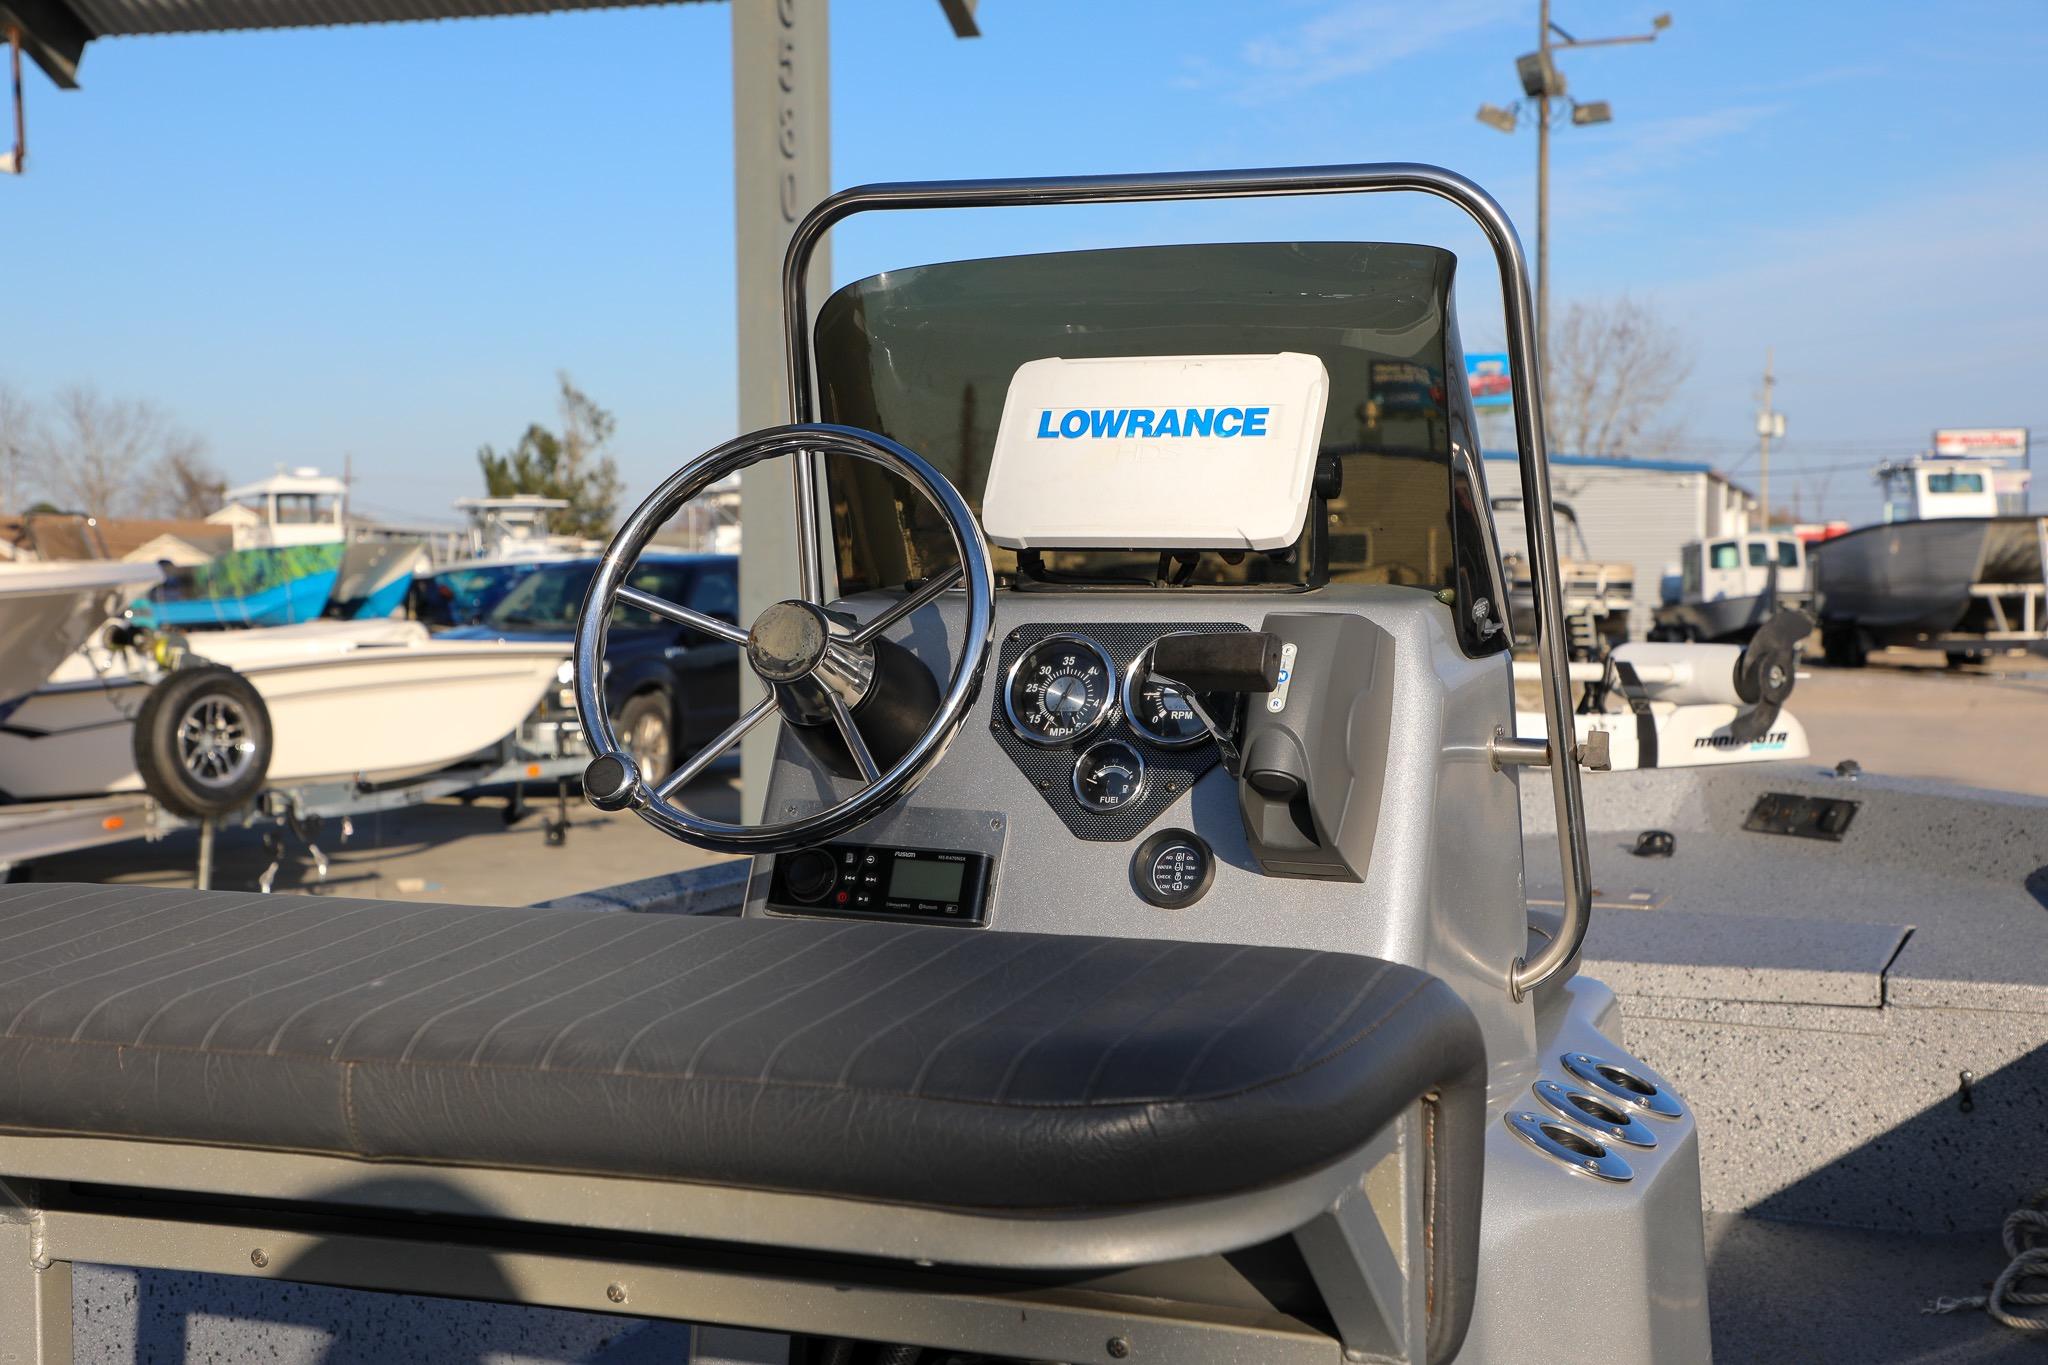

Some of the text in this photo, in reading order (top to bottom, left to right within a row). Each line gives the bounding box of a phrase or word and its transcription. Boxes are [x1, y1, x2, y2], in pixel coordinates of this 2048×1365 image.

[1037, 407, 1270, 439] LOWRANCE
[1062, 656, 1075, 666] 35
[1038, 665, 1052, 675] 30
[1279, 672, 1286, 680] N
[1026, 683, 1039, 693] 25
[1029, 714, 1042, 724] 15
[1152, 715, 1159, 724] 0
[1170, 711, 1193, 720] RPM
[1049, 727, 1073, 737] MPH
